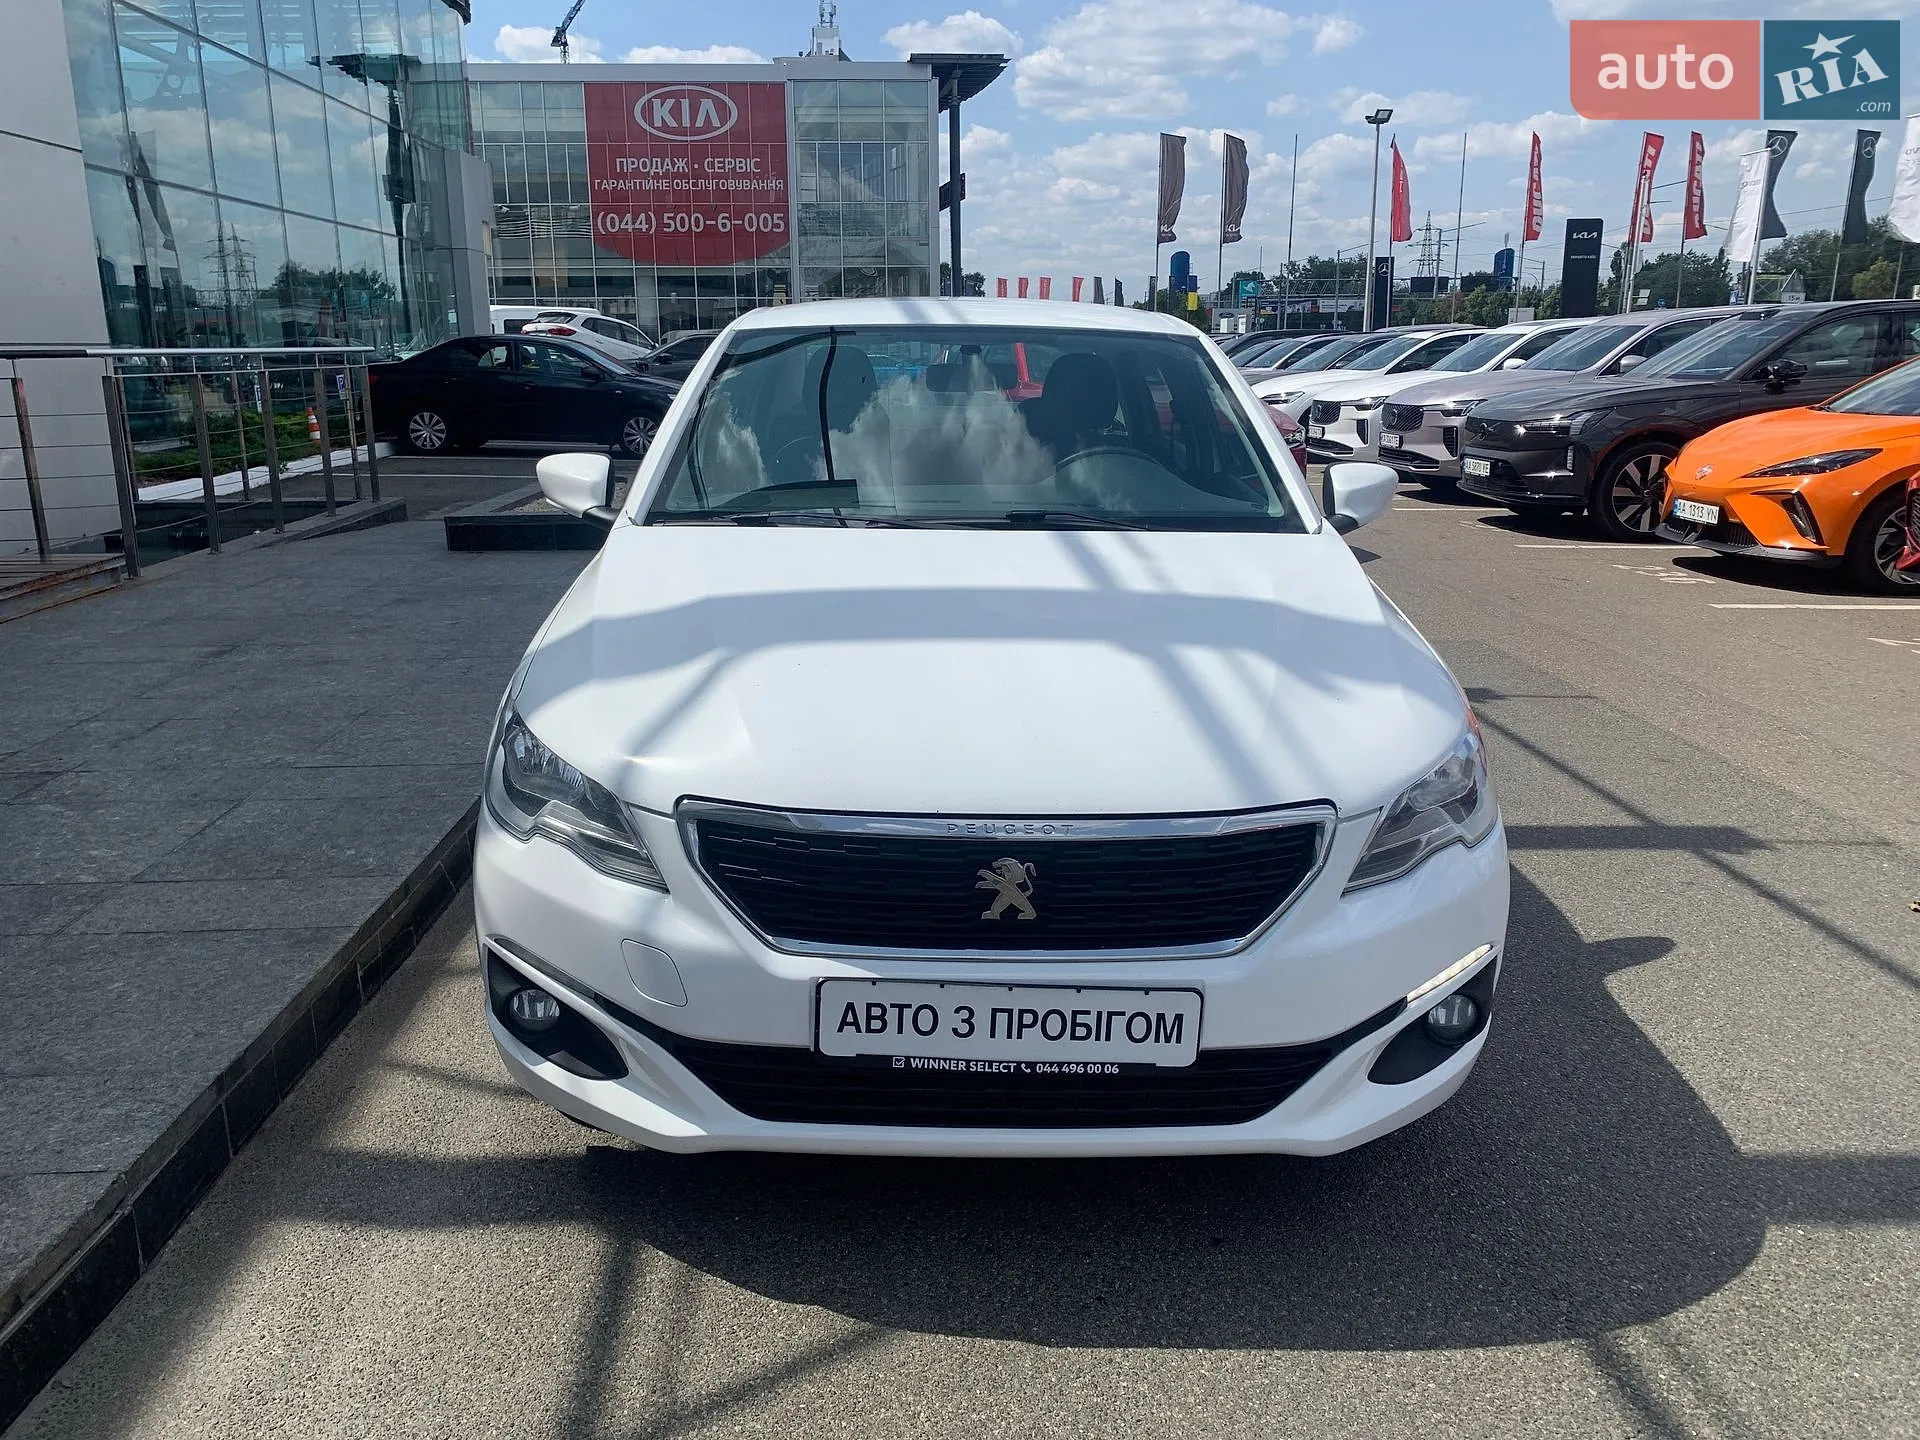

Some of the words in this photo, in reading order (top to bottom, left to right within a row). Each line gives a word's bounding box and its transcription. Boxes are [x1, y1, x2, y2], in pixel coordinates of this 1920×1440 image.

[651, 98, 722, 128] KIA
[616, 157, 689, 175] ПРОДАЖ
[704, 157, 761, 173] СЕРВІС
[595, 178, 670, 191] ГАРАНТІЙНЕ
[673, 179, 784, 191] ОБСЛУГОВУВАННЯ
[597, 211, 657, 234] (044)
[663, 212, 785, 233] 500-6-005
[1689, 504, 1704, 518] 1313
[1706, 507, 1718, 523] YN
[946, 822, 1075, 836] PEUGEOT
[836, 1001, 940, 1037] АВТО
[951, 1005, 976, 1039] З
[989, 1007, 1185, 1045] ПРОБІГОМ
[910, 1057, 967, 1072] WINNER
[969, 1061, 1017, 1074] SELECT
[1035, 1063, 1060, 1075] 044
[1061, 1063, 1085, 1075] 496
[1086, 1064, 1102, 1075] 00
[1103, 1064, 1120, 1075] 06
